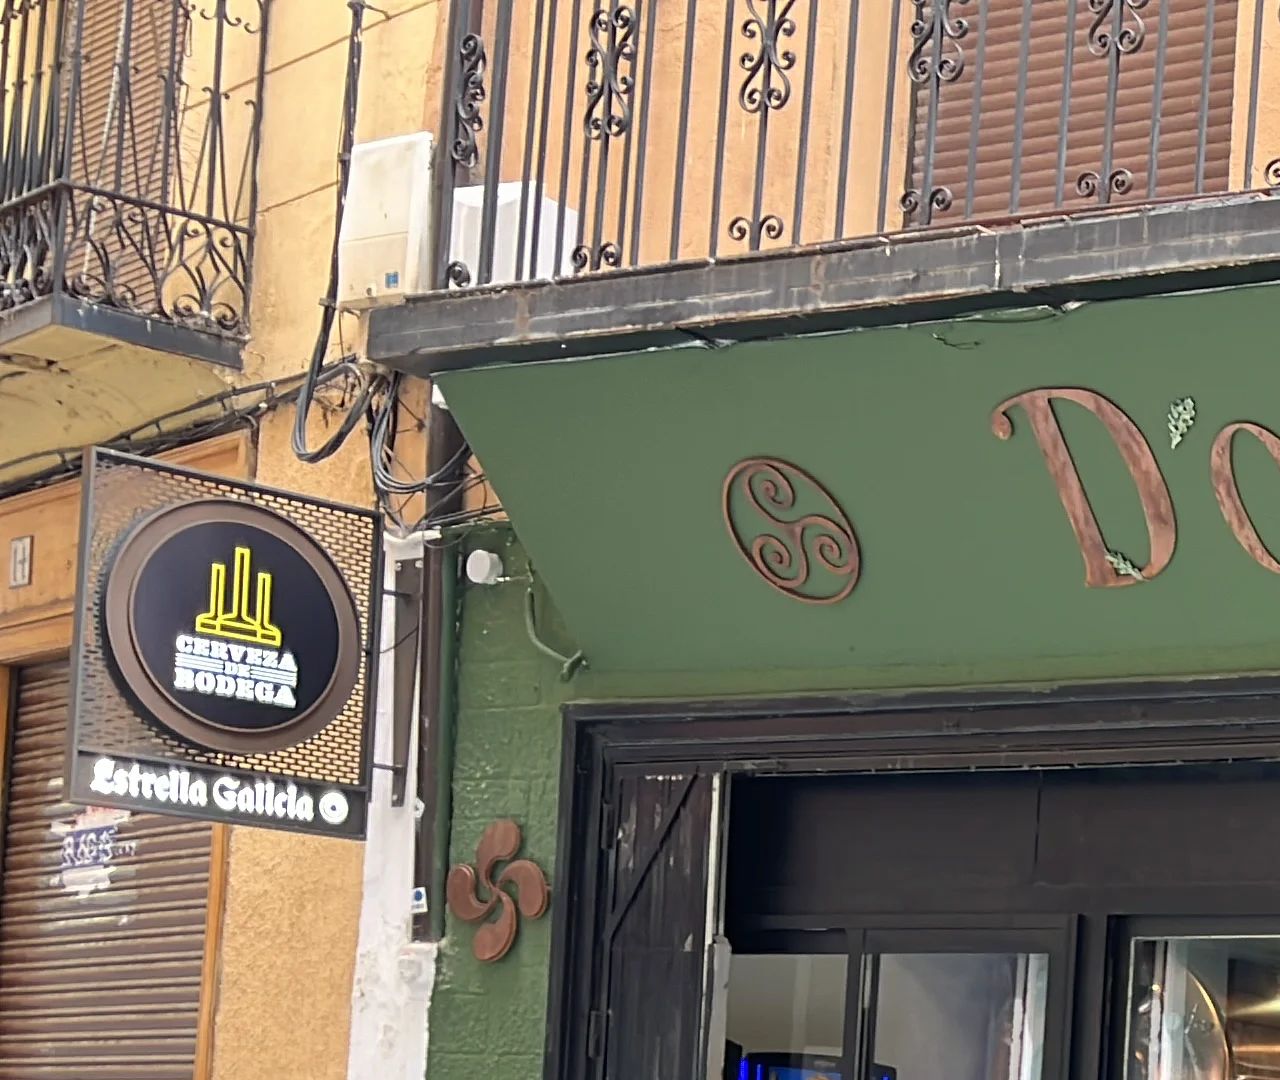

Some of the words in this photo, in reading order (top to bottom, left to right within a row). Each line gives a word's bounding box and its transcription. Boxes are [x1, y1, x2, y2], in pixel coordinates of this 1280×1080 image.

[175, 634, 298, 673] CERVEZA
[223, 661, 252, 678] DE
[173, 666, 297, 709] BODEGA
[90, 757, 208, 807] Estrella
[212, 776, 315, 822] Galicia
